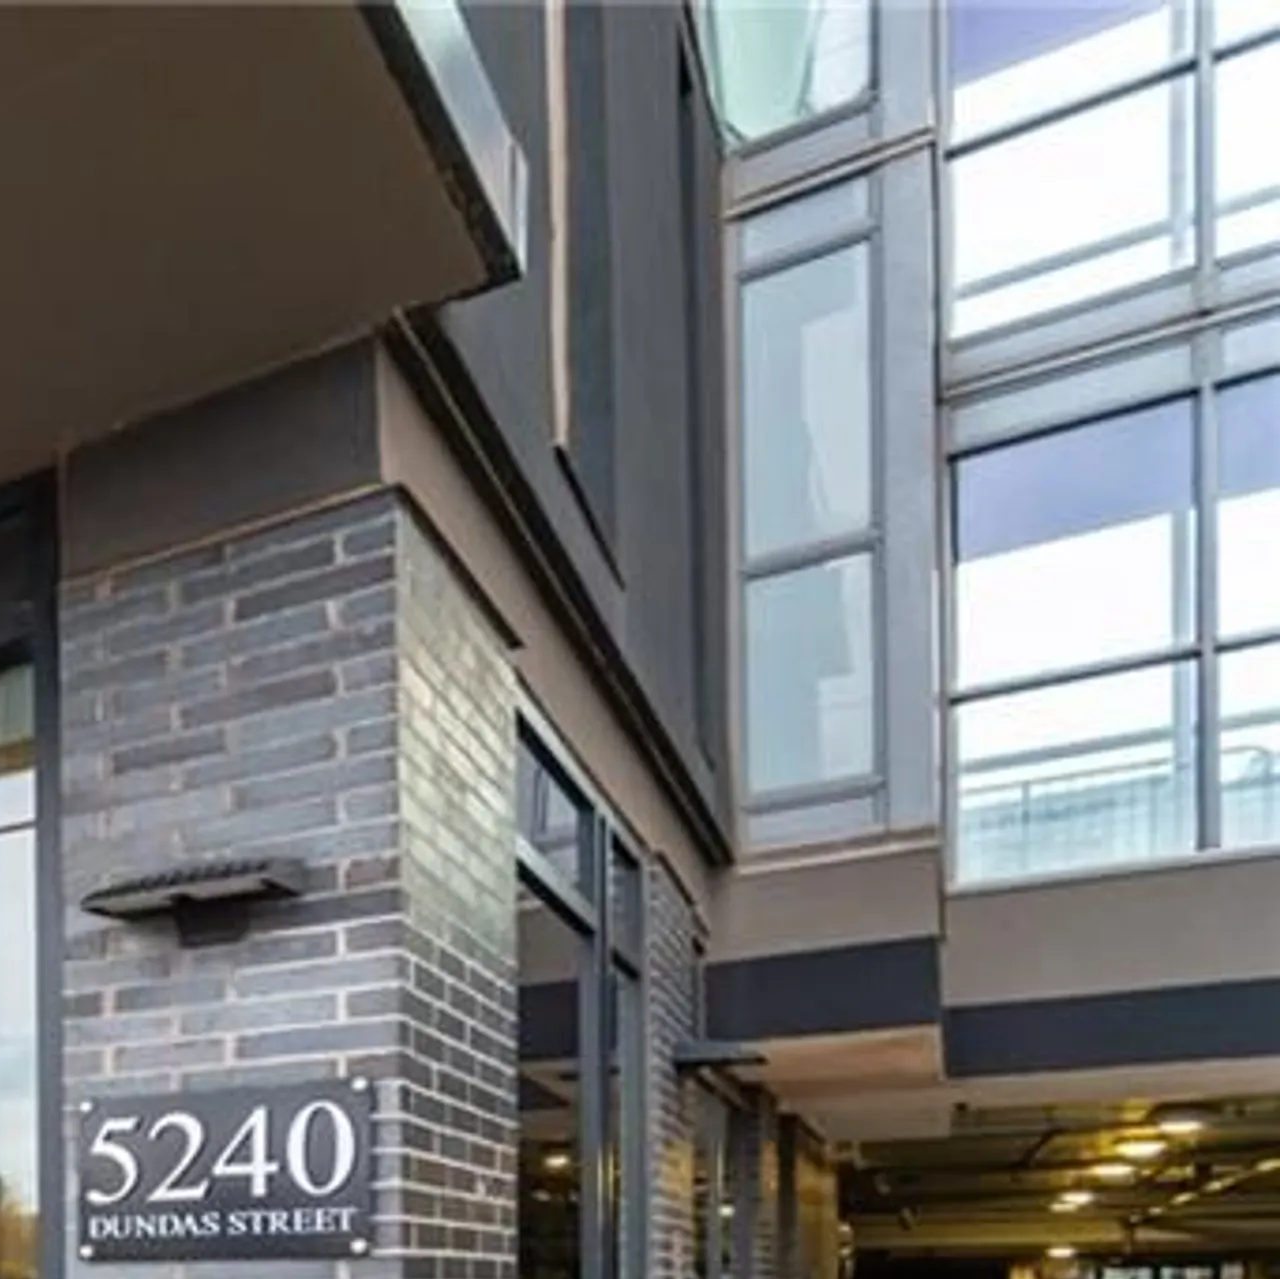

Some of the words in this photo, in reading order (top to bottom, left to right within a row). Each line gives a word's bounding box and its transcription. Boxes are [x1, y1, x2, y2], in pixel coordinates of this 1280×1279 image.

[85, 1100, 355, 1205] 5240
[90, 1212, 221, 1238] DUNDAS
[227, 1206, 357, 1234] STREET
